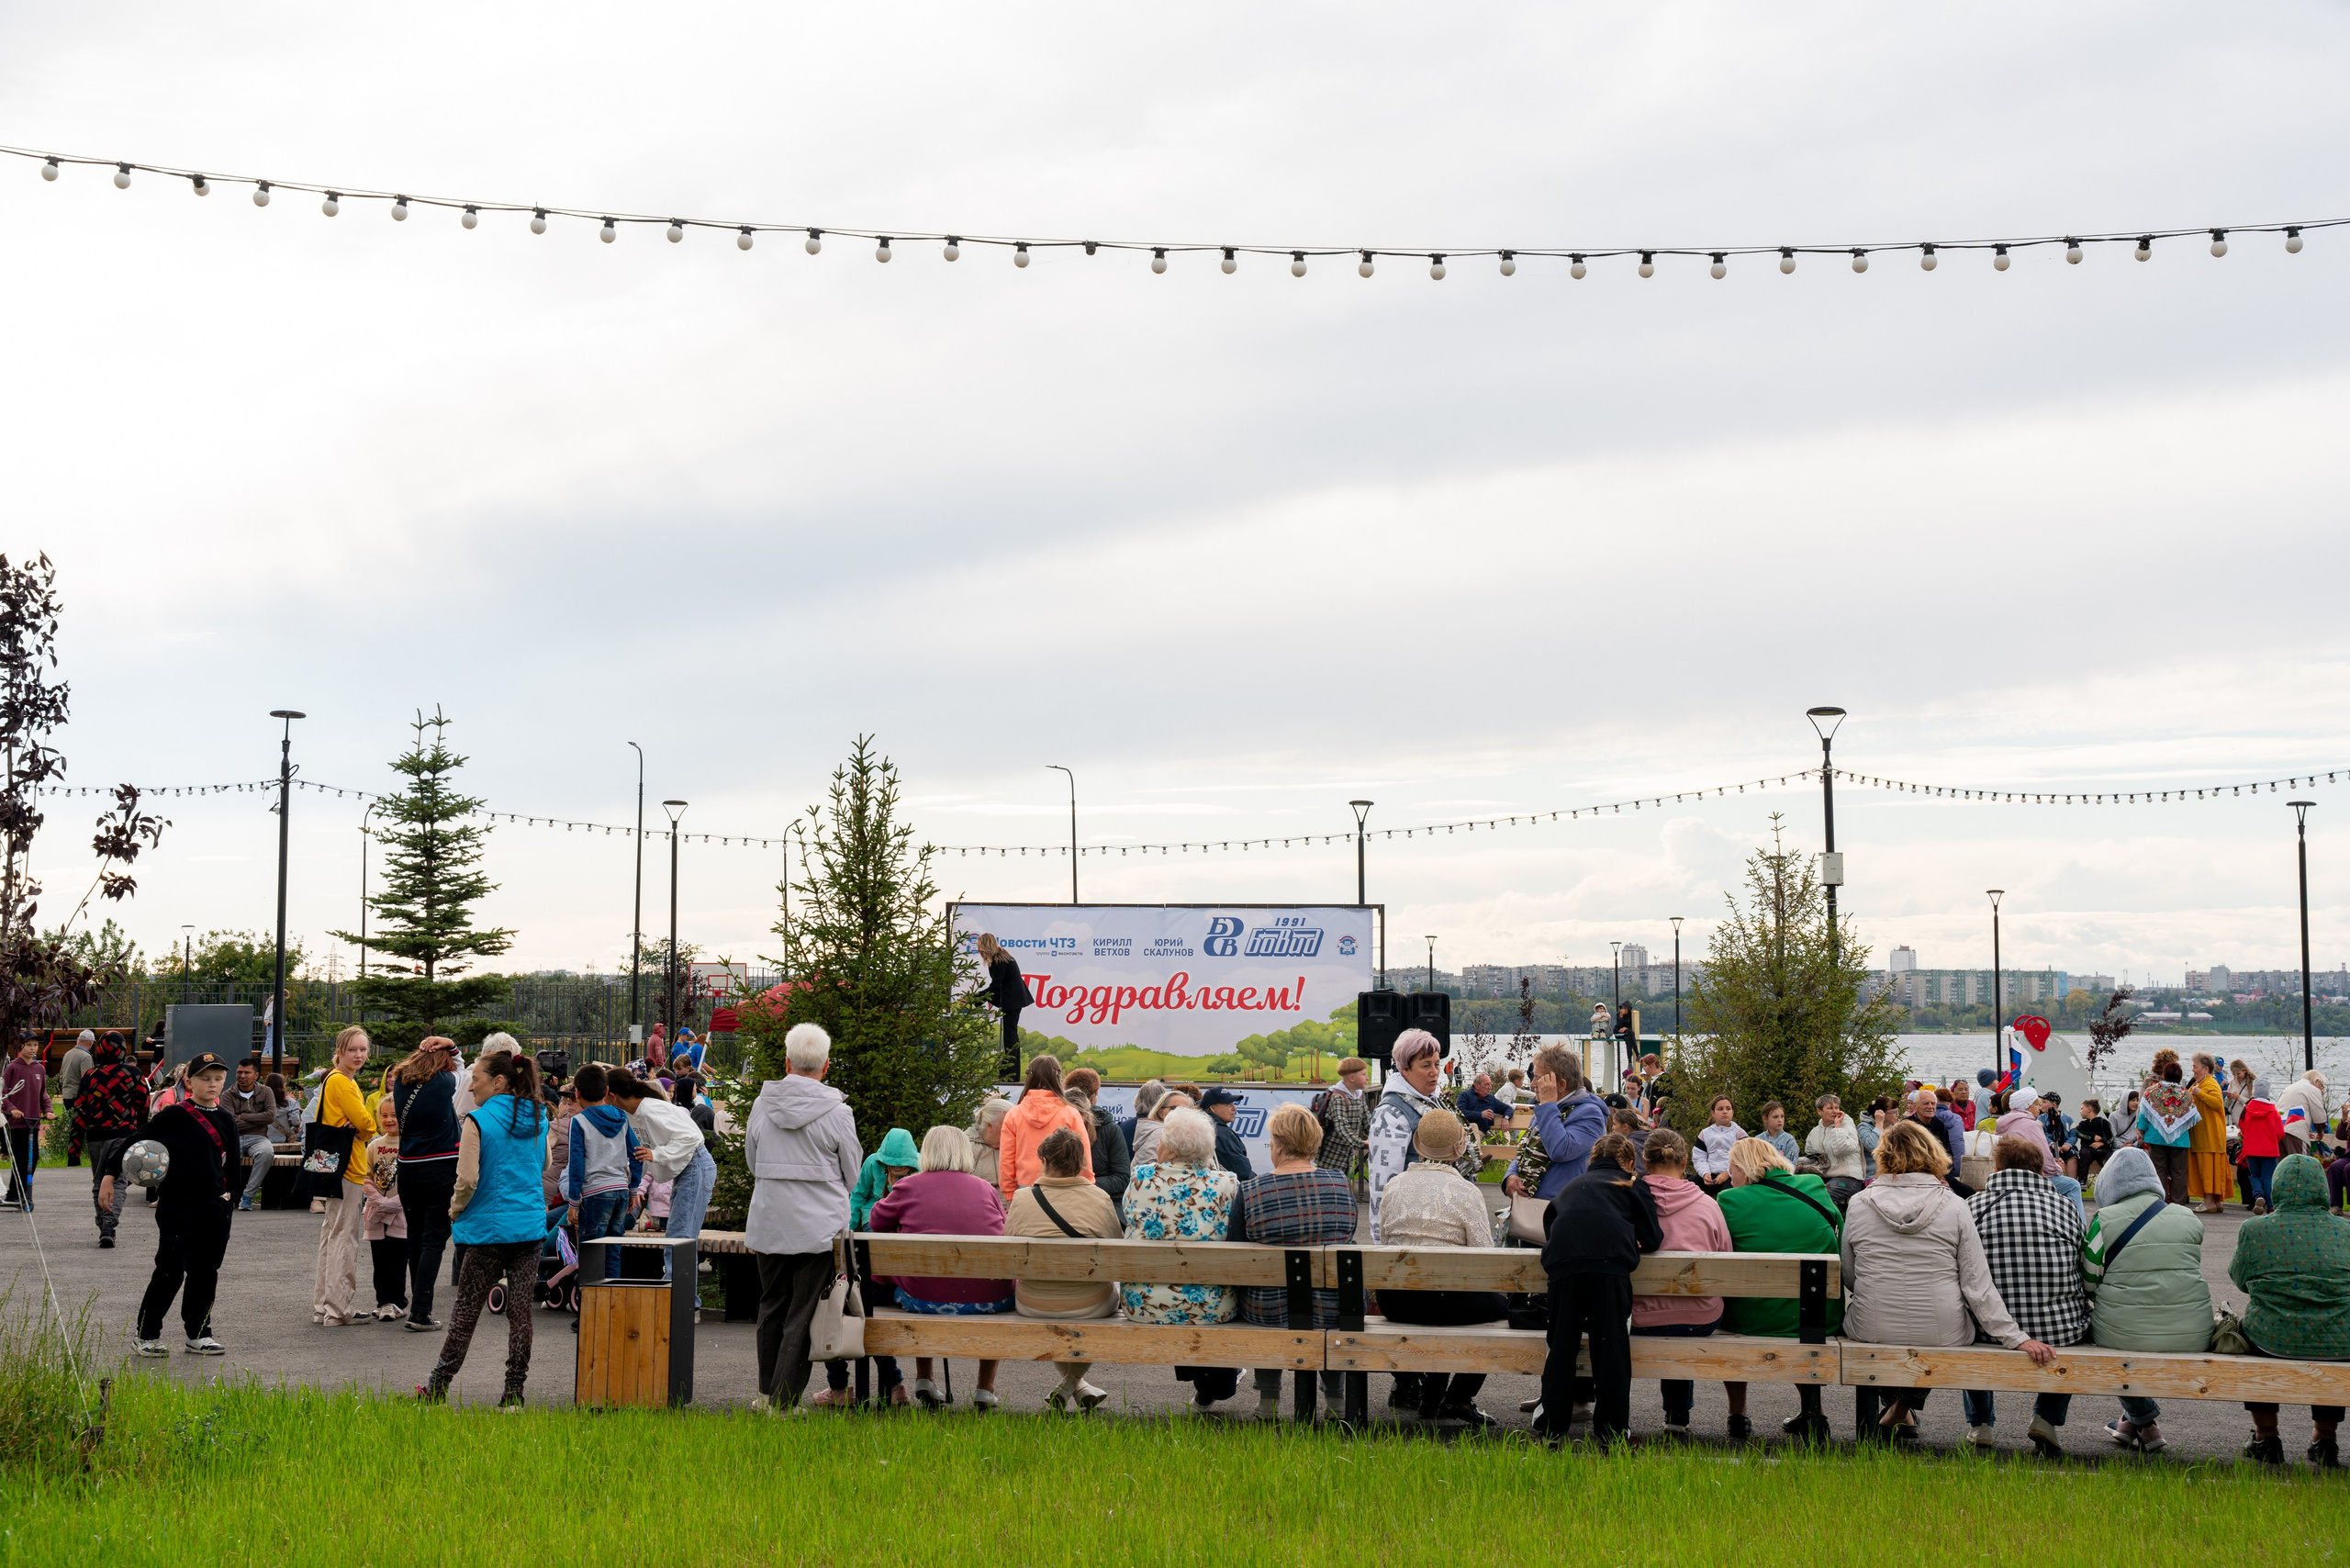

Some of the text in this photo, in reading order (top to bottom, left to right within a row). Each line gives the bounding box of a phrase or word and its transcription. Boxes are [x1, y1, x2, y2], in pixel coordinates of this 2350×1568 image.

[1274, 917, 1306, 927] 1991
[996, 936, 1076, 948] овости ЧТЗ
[1092, 938, 1132, 946] КИРИЛЛ
[1154, 936, 1183, 946] ЮРИЙ
[1094, 948, 1131, 957] ВЕТХОВ
[1143, 948, 1194, 957] СКАЛУНОВ
[1020, 971, 1306, 1025] Поздравляем!
